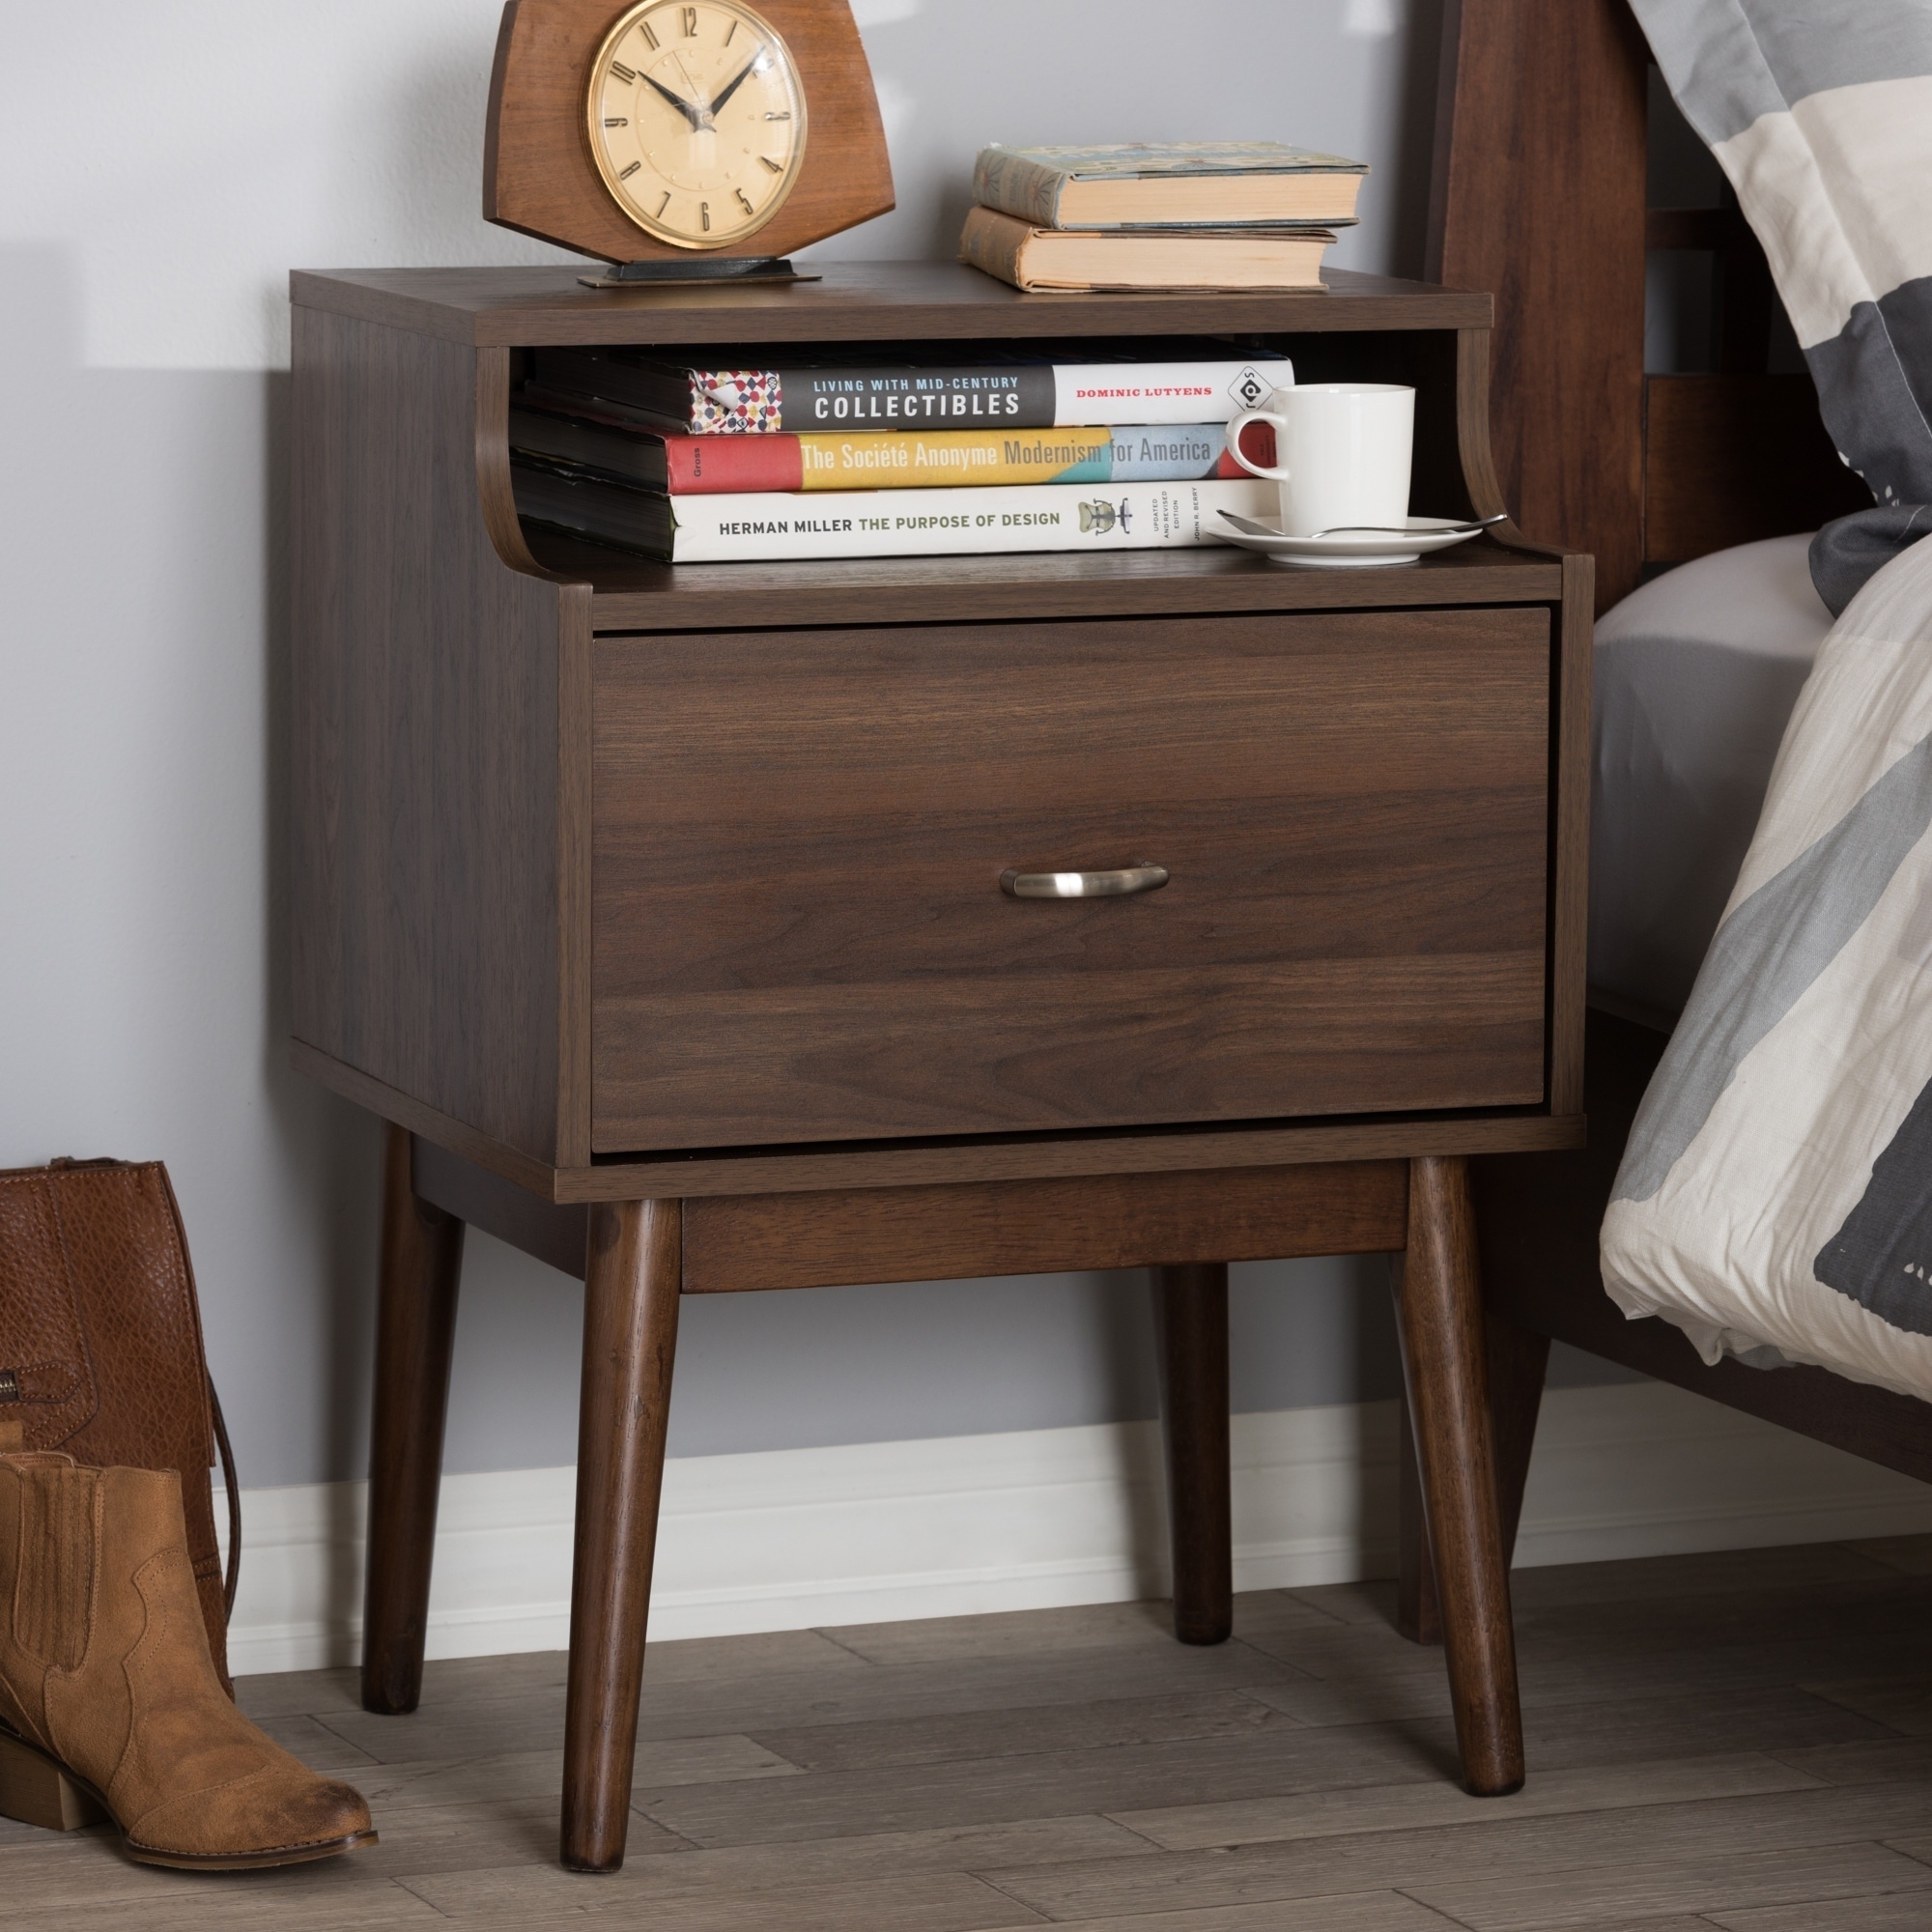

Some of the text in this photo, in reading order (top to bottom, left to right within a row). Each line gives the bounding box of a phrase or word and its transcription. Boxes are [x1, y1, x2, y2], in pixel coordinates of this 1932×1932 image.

[682, 7, 697, 38] 12
[639, 21, 661, 51] 11
[610, 60, 637, 86] 10
[604, 117, 628, 128] 9
[764, 111, 791, 122] 3
[619, 160, 641, 181] 8
[759, 156, 783, 174] 4
[657, 190, 671, 219] 7
[735, 187, 753, 215] 5
[701, 201, 710, 232] 6
[813, 377, 1018, 392] LIVING WITH MID-CENTURY
[1076, 386, 1212, 398] DOMINIC LUTYENS
[814, 393, 1019, 419] COLLECTIBLES
[801, 437, 1210, 471] The Société Anonyme Modernism for America
[720, 513, 1060, 535] HERMAN MILLER THE PURPOSE OF DESIGN
